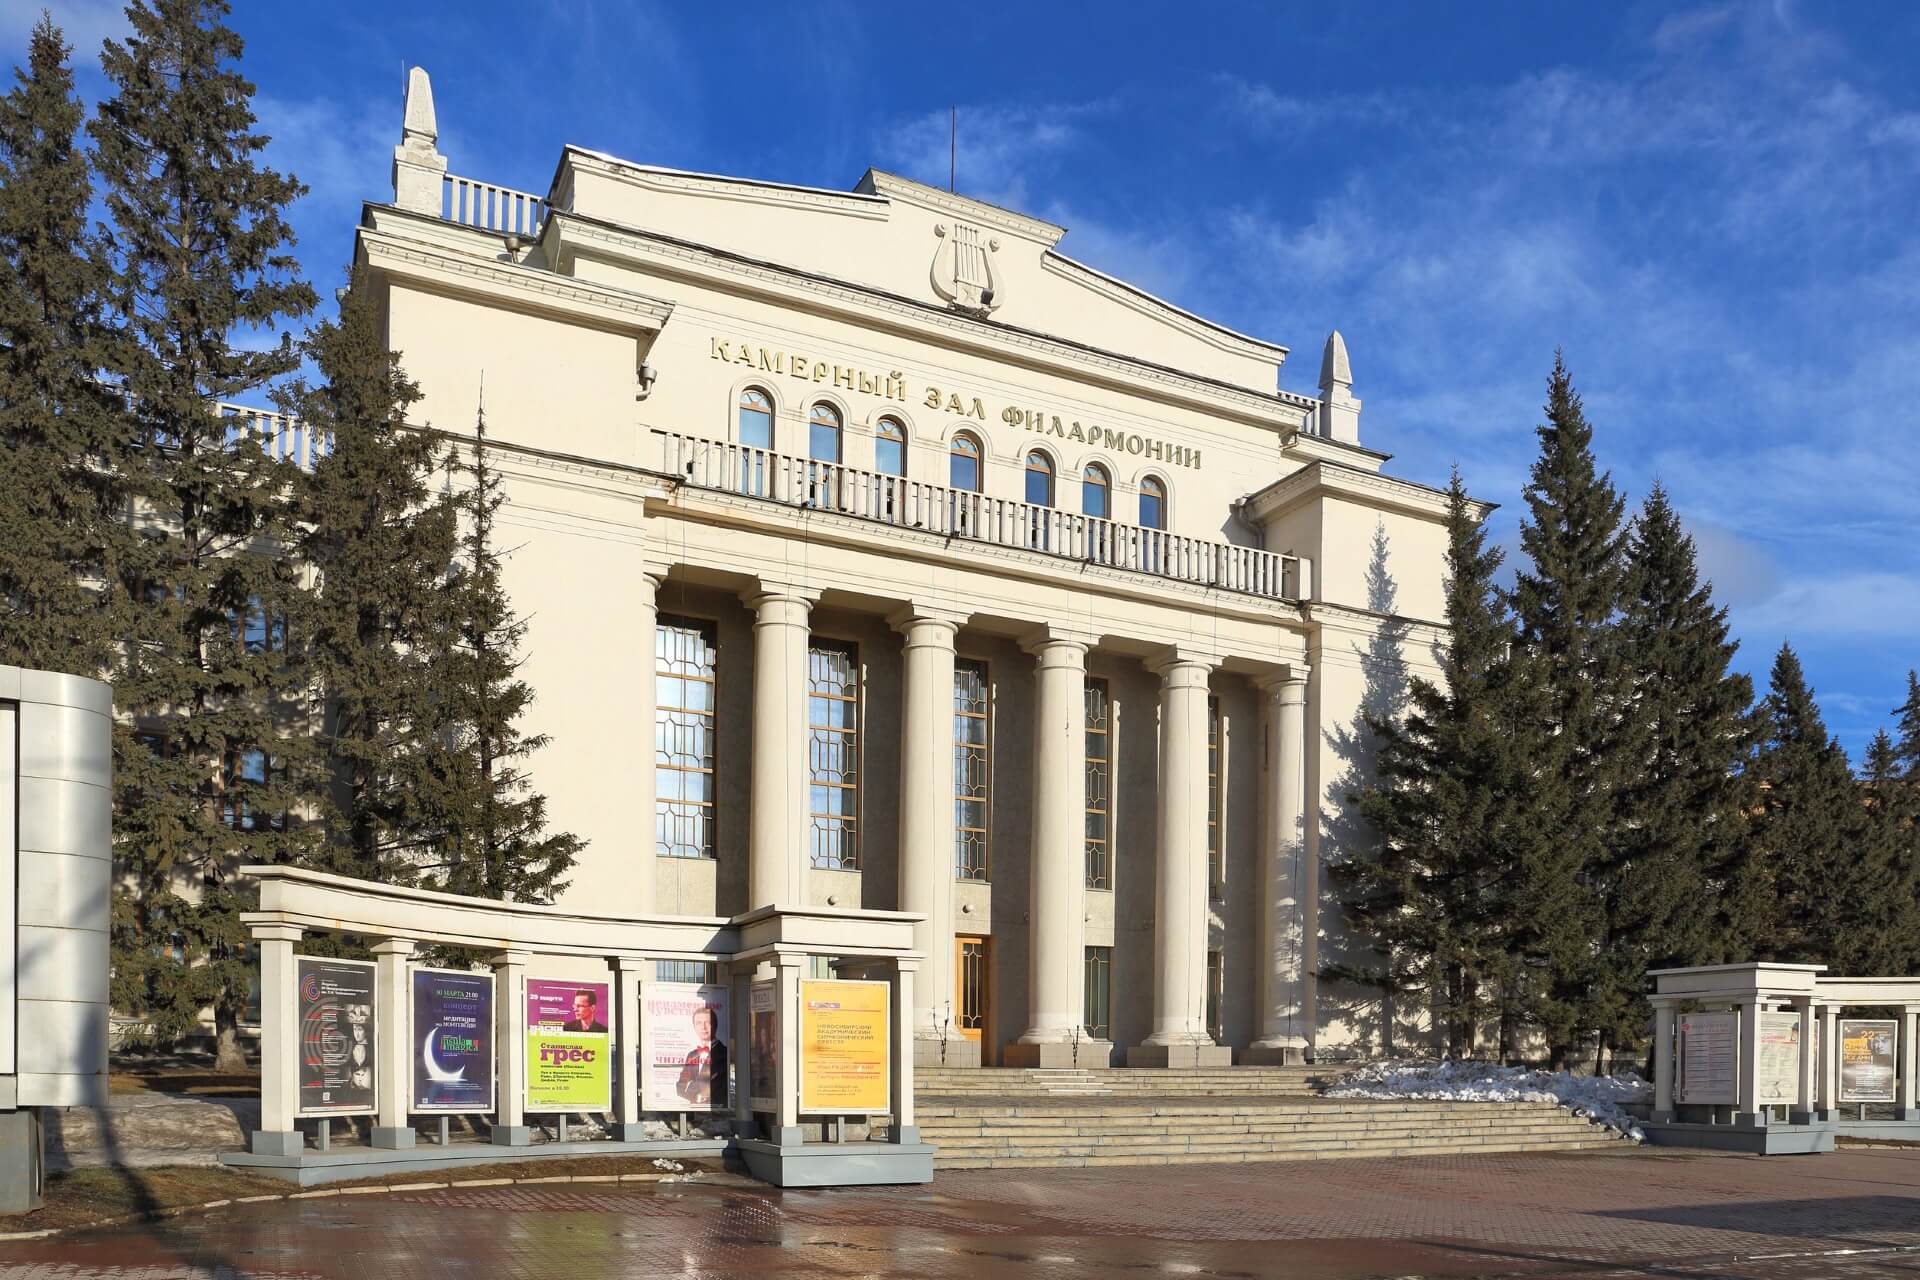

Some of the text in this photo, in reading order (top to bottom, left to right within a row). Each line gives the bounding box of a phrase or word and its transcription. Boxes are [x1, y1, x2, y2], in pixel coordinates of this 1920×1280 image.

[710, 335, 1202, 470] КАМЕРНЫЙ ЗАЛ ФИЛАРМОНИИ
[1861, 1030, 1875, 1040] 22
[540, 1049, 596, 1065] грес
